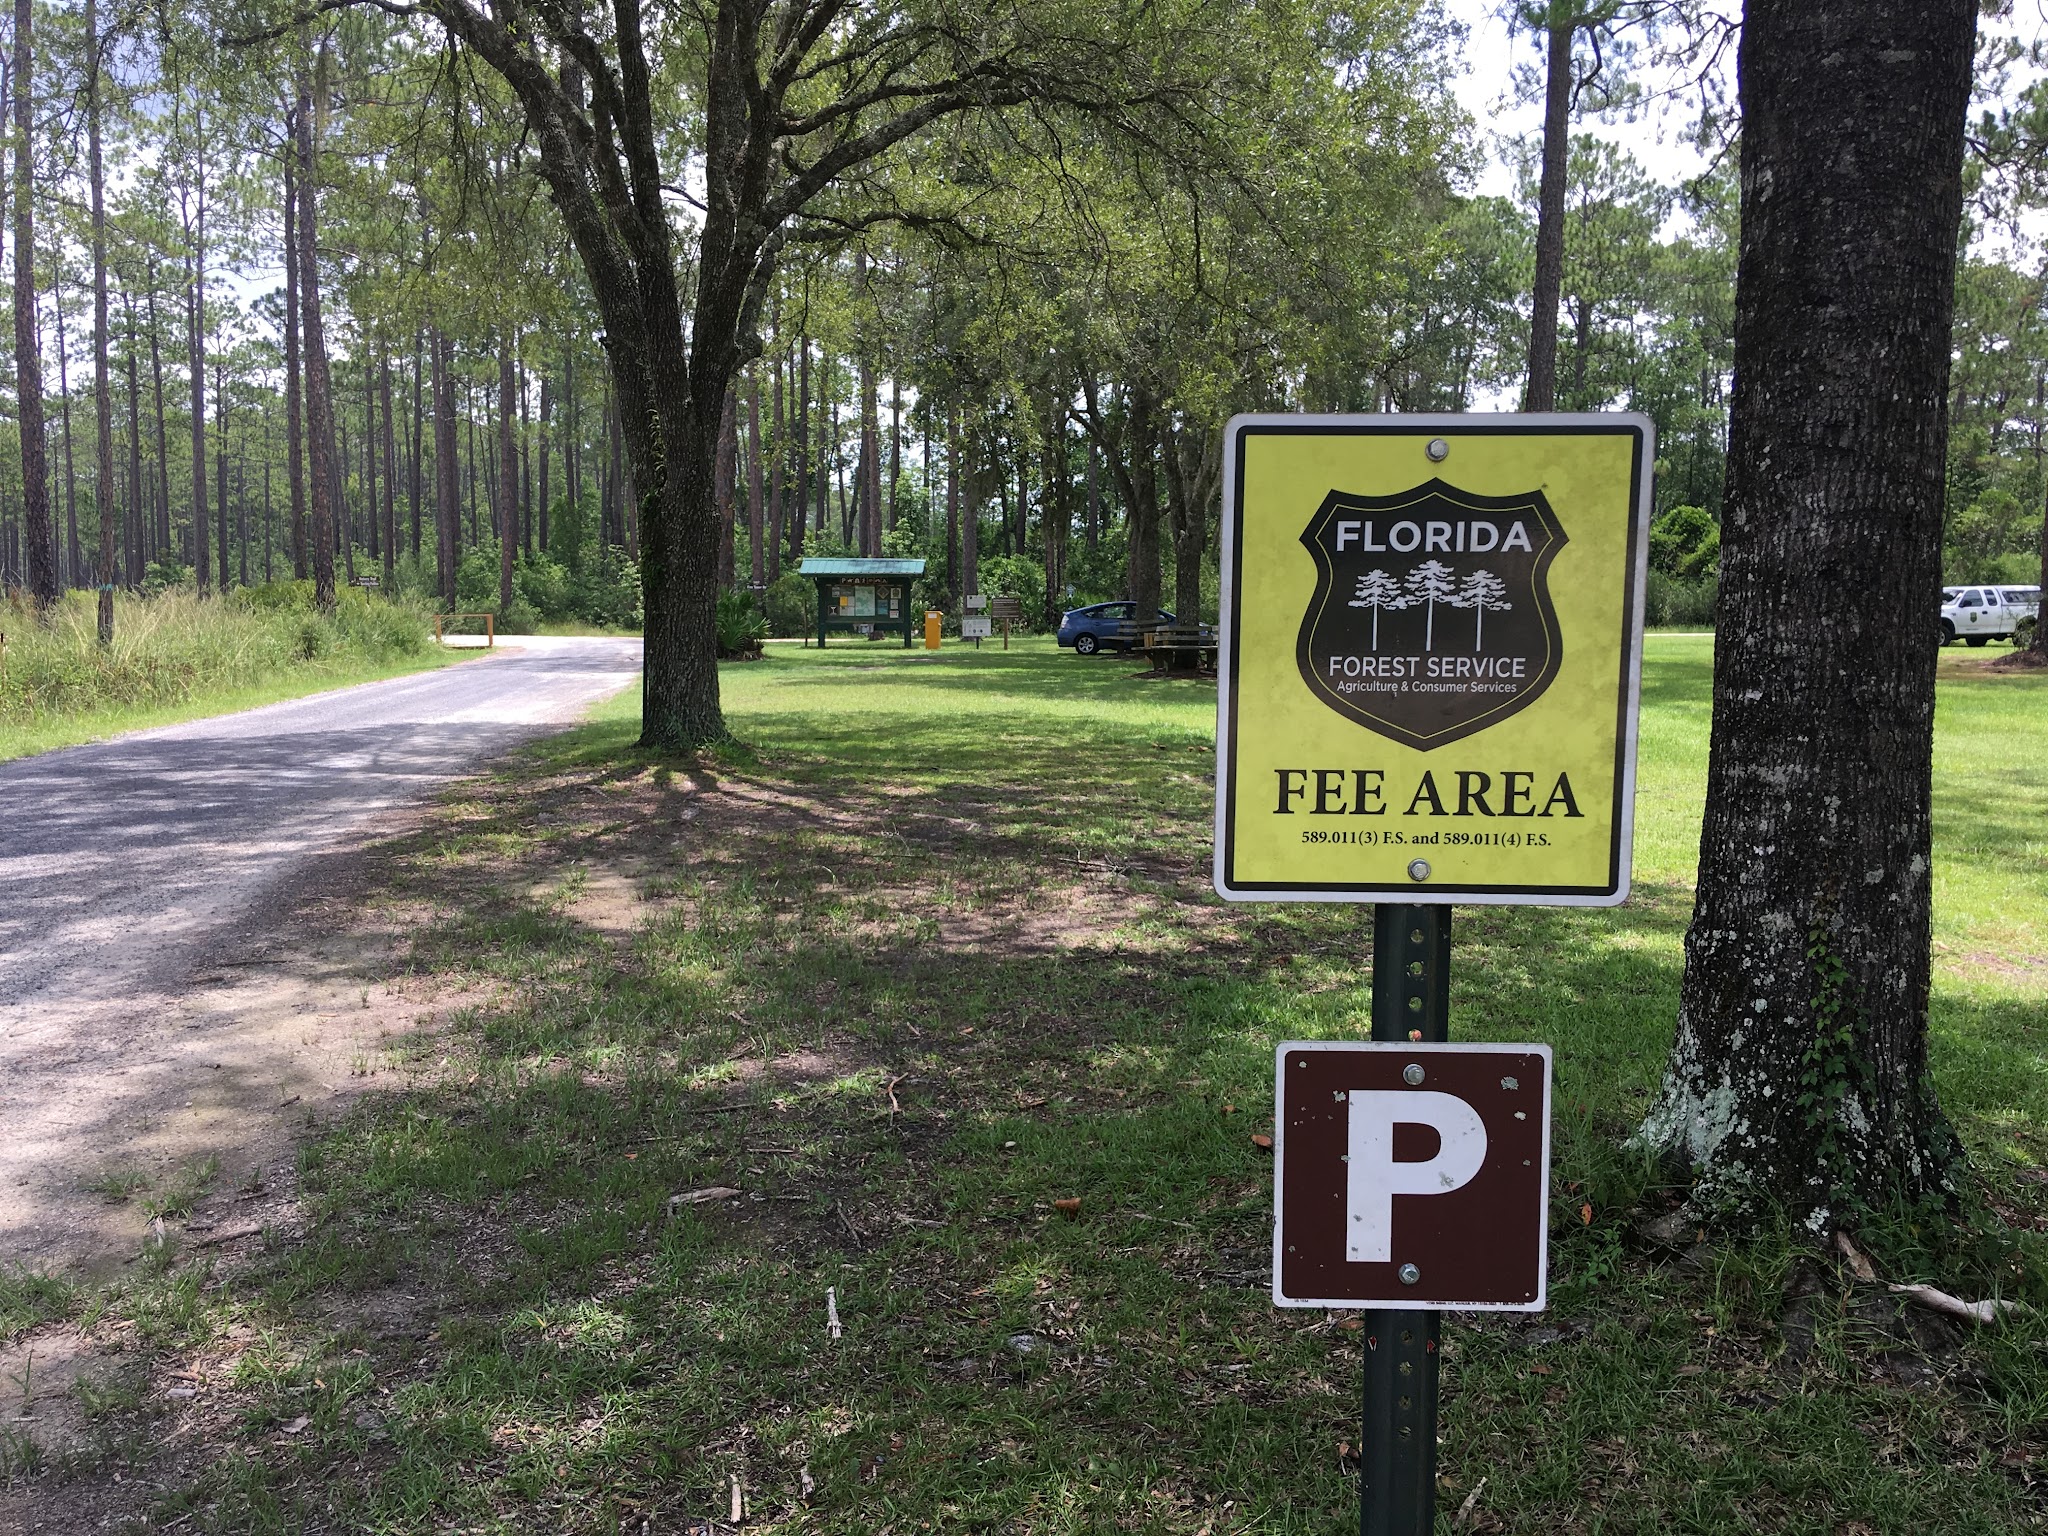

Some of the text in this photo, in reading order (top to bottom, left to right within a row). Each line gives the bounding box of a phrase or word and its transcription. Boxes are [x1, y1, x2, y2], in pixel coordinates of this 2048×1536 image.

[1335, 520, 1533, 553] FLORIDA
[1329, 656, 1527, 678] FOREST SERVICE
[1336, 680, 1517, 693] Agriculture & Consumer Services
[1273, 769, 1585, 818] FEE AREA
[1301, 831, 1552, 848] 589.011(3) F.S. and 589.011(4) F.S.
[1346, 1089, 1488, 1263] P
